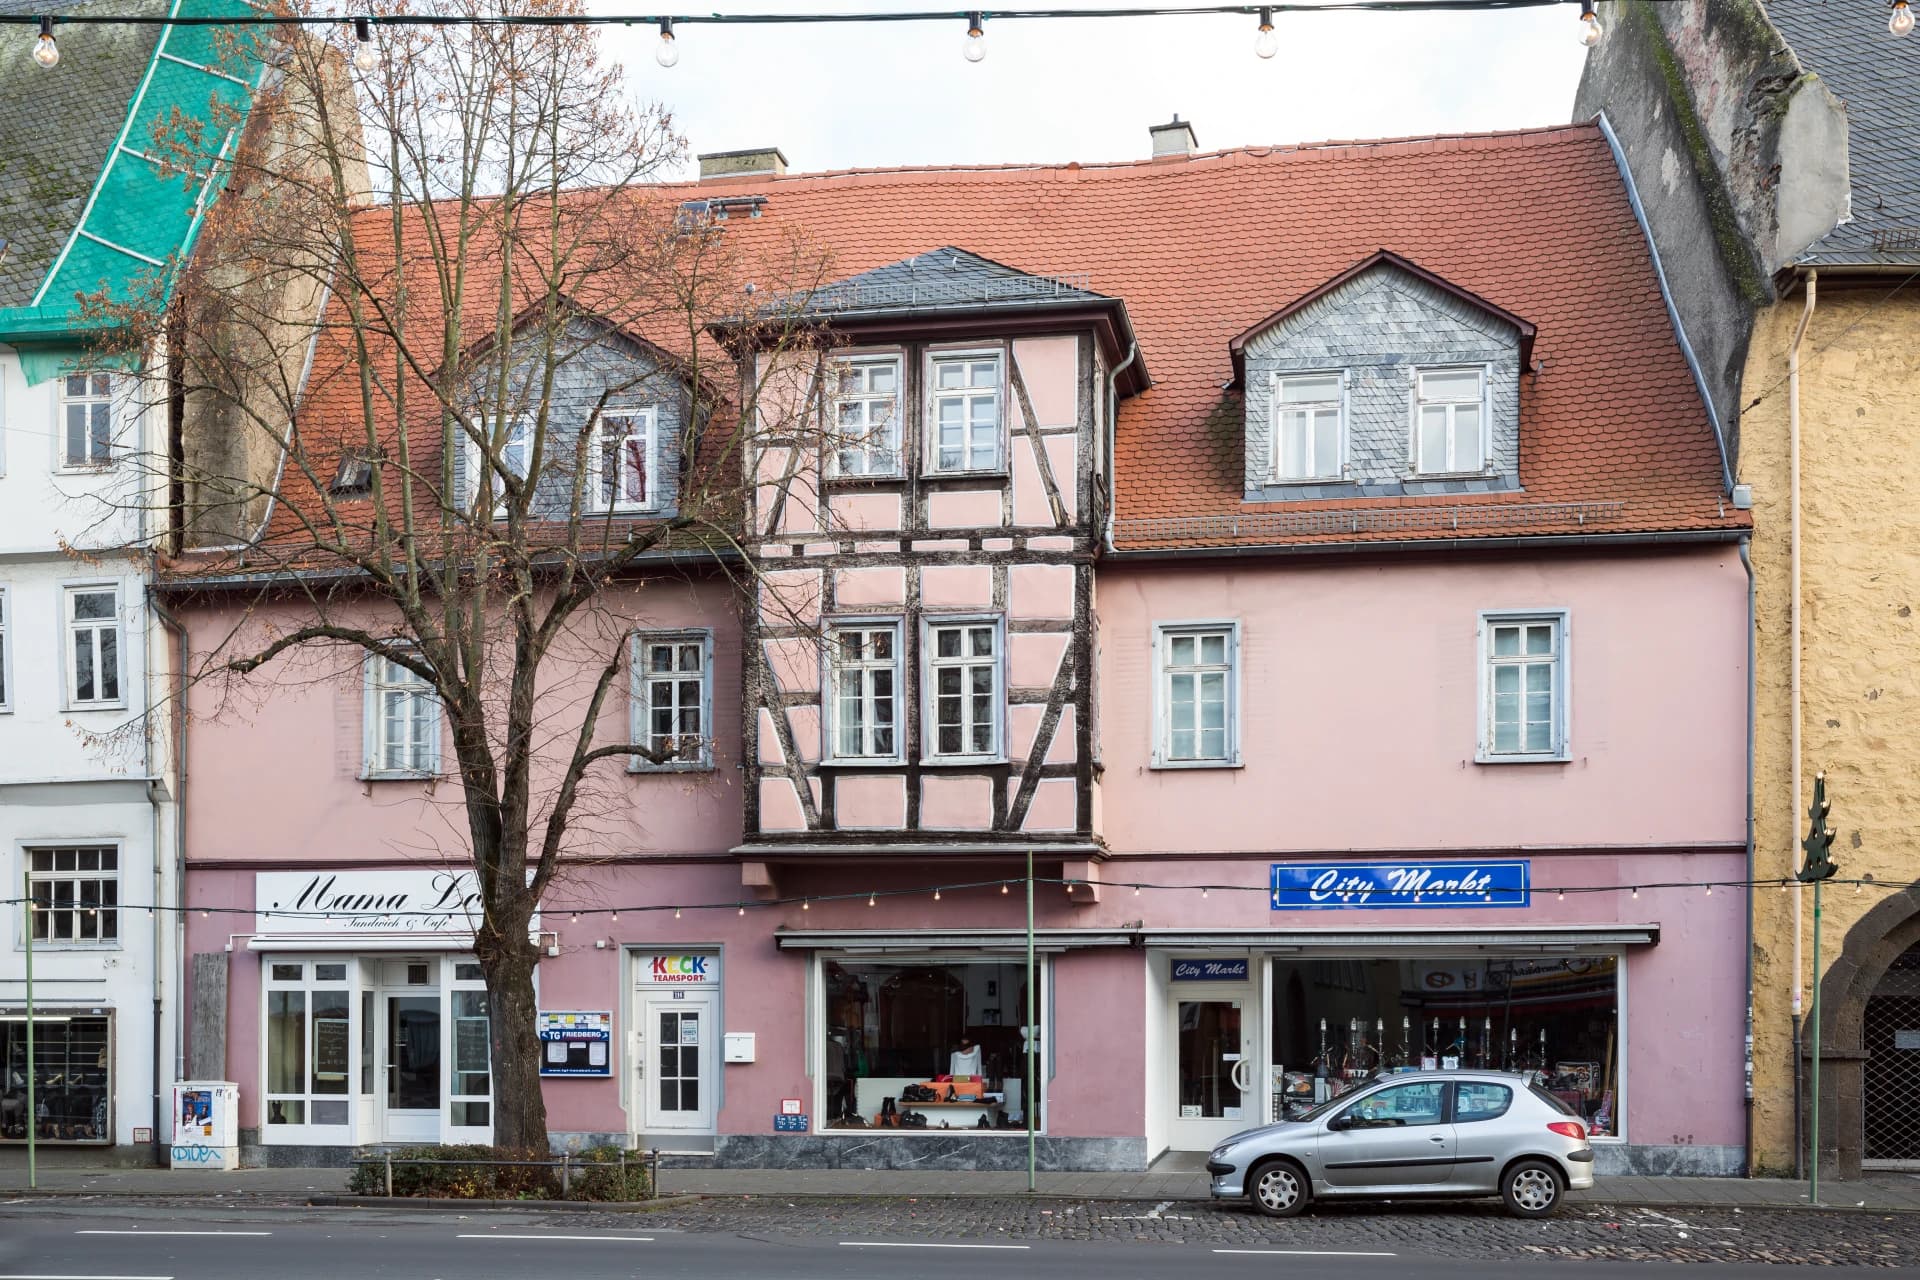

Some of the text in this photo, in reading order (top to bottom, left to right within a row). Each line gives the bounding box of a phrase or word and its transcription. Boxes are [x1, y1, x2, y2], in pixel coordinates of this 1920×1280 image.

[1309, 868, 1491, 903] City Markt
[273, 874, 409, 911] Mama
[343, 916, 401, 928] Sandwich
[1175, 963, 1246, 977] City Markt
[653, 974, 705, 982] TEAMSPORT
[549, 1031, 561, 1040] TG
